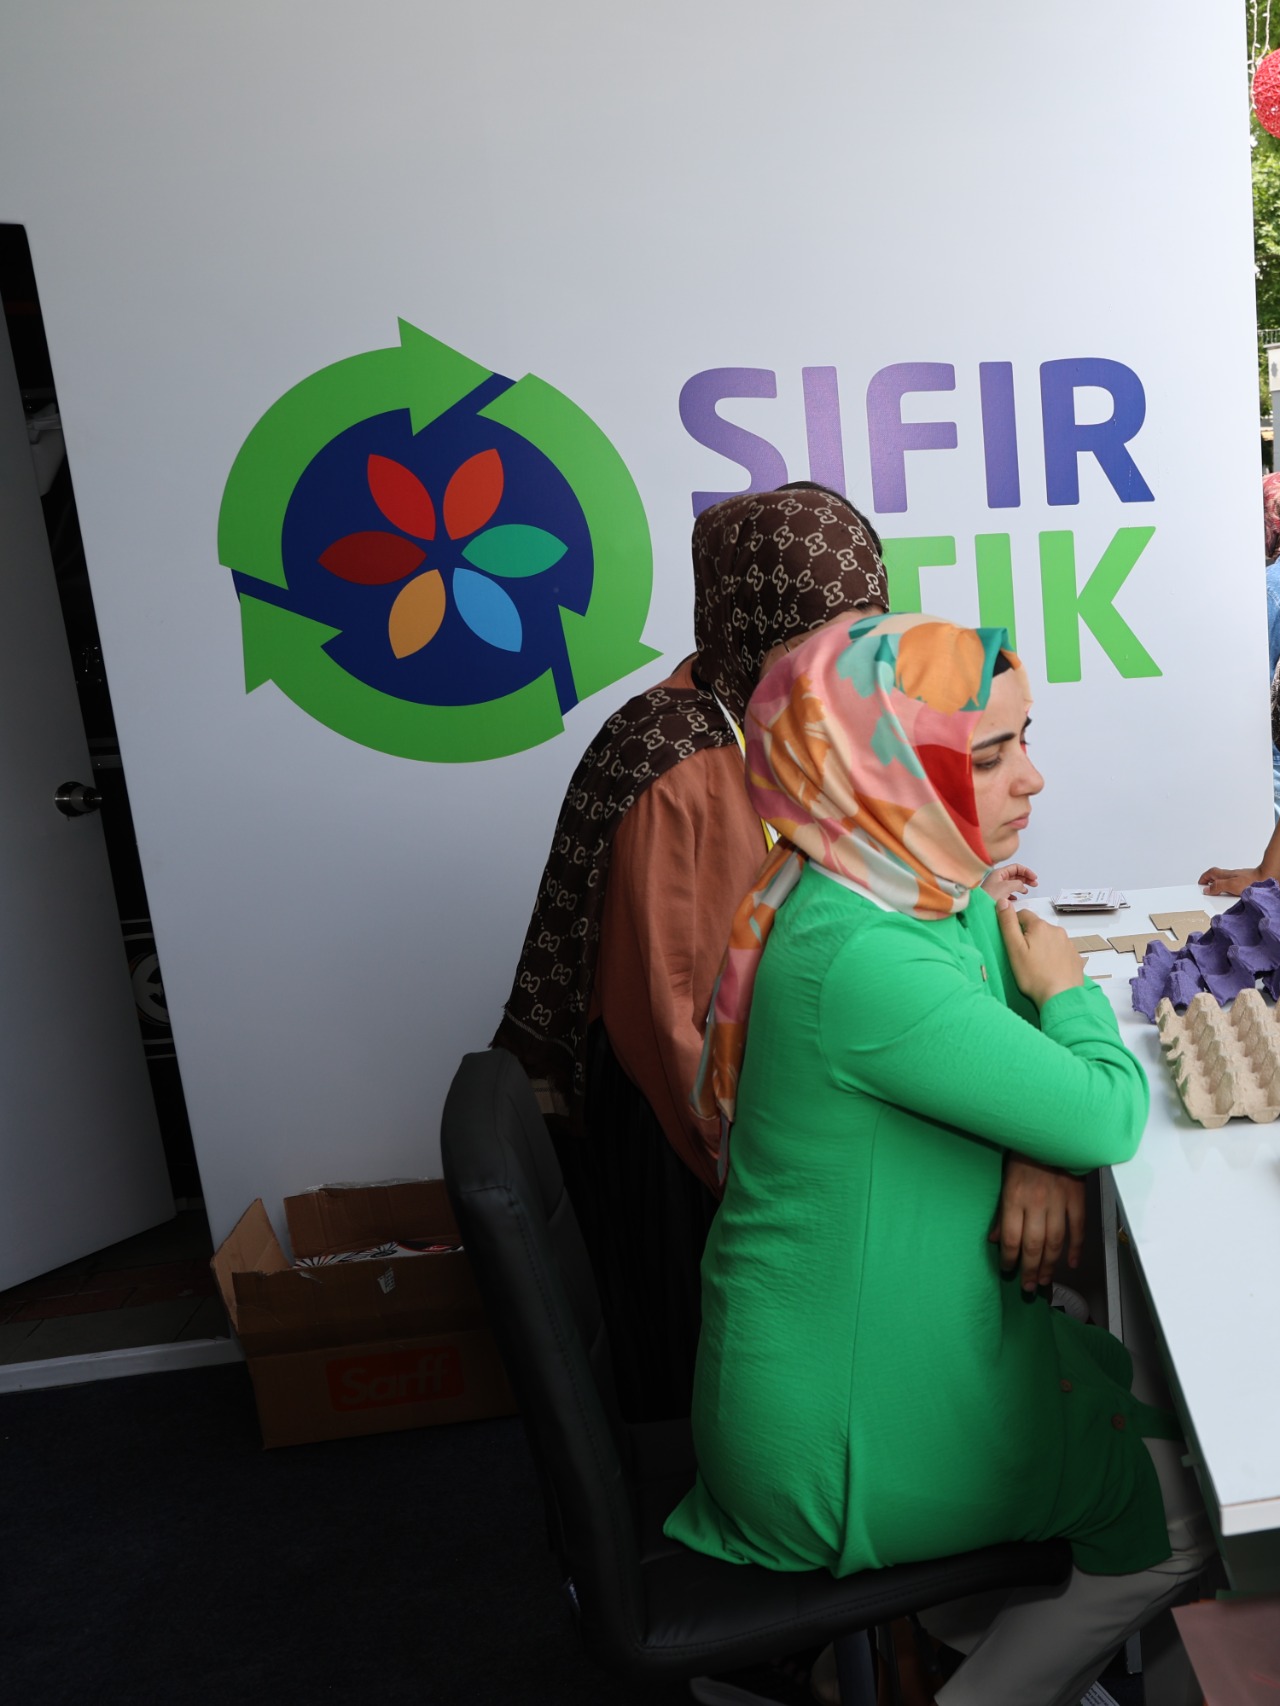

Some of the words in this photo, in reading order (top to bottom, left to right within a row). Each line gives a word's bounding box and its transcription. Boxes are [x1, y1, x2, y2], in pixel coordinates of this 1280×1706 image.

[678, 357, 1156, 518] SIFIR
[879, 525, 1163, 684] TIK
[341, 1351, 450, 1405] Sarff
